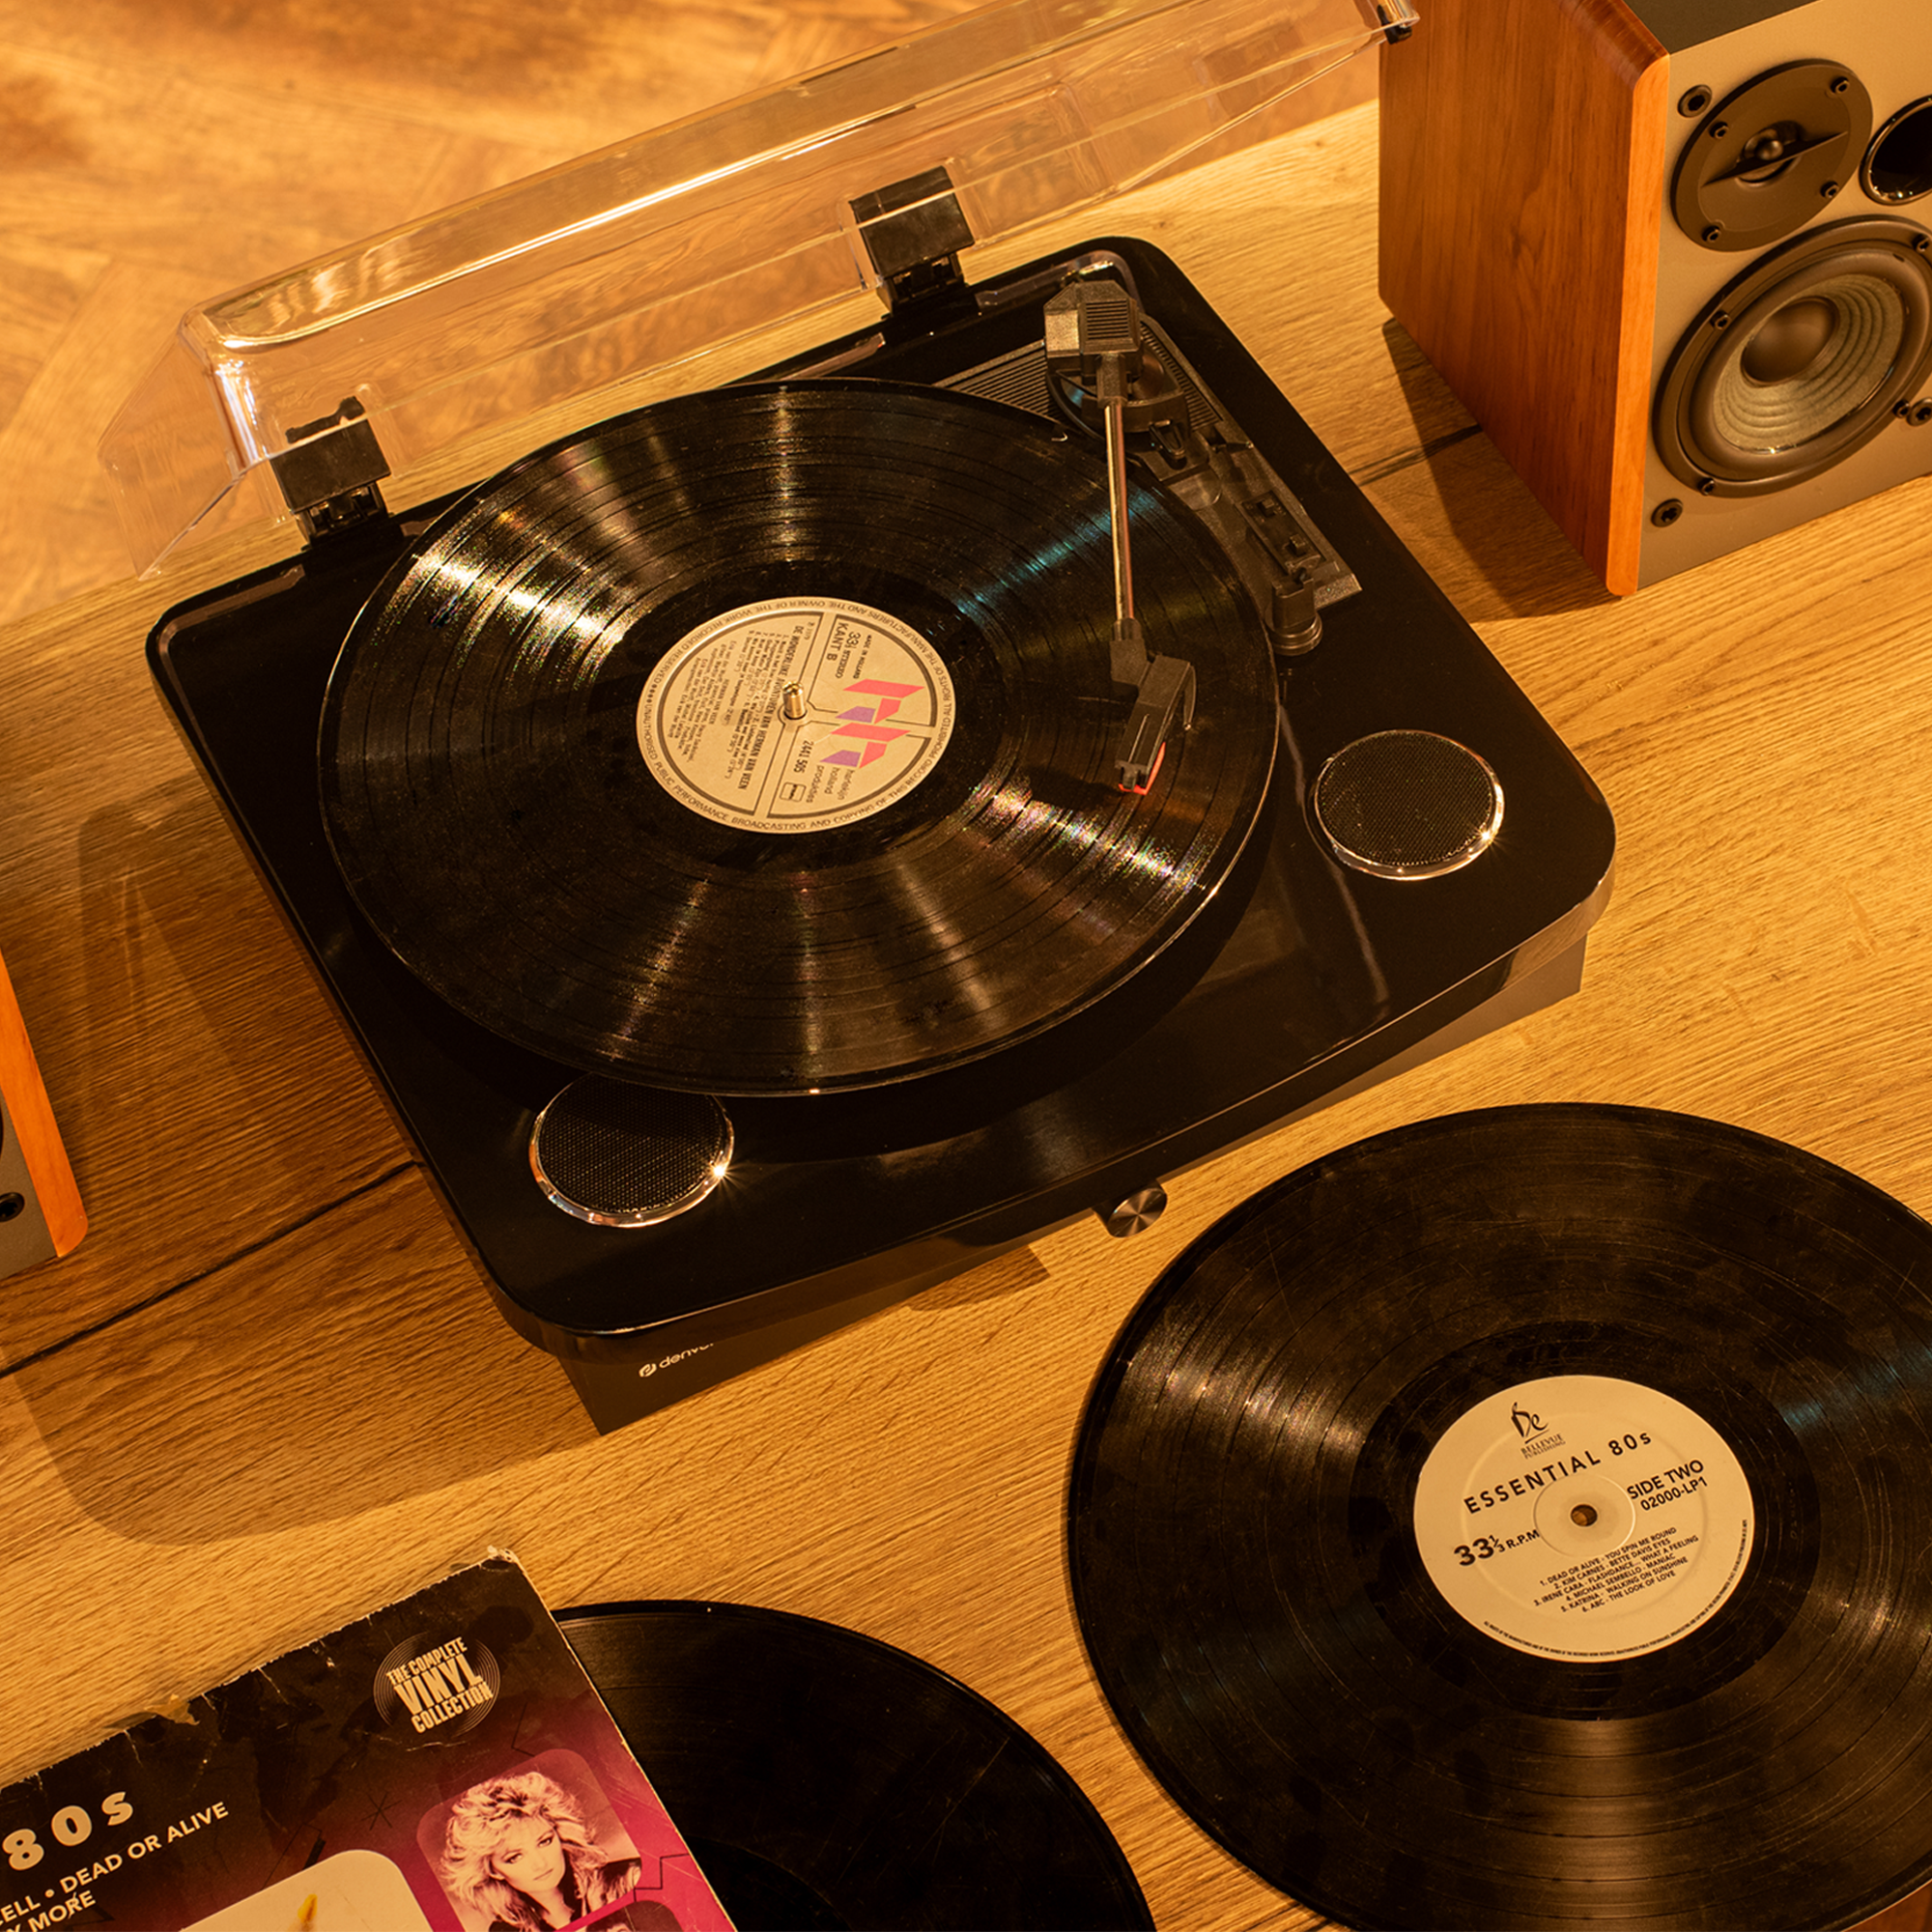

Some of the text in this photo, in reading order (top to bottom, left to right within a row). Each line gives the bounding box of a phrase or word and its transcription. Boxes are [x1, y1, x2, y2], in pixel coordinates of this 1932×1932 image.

[721, 608, 752, 623] WORK
[753, 603, 772, 611] THE
[828, 601, 846, 610] THE
[846, 604, 868, 614] AND
[677, 618, 723, 650] RECORDED
[792, 625, 805, 635] DE
[830, 622, 849, 650] KANT
[867, 611, 929, 653] MANUFACTURERS
[923, 651, 938, 666] THE
[932, 663, 945, 675] OF
[938, 675, 952, 701] RIGHTS
[759, 716, 773, 728] VAN
[943, 702, 952, 715] ALL
[750, 729, 767, 756] HERMAN
[793, 740, 814, 774] 2441 505
[650, 761, 674, 787] PUBLIC
[669, 785, 729, 821] PERFORMANCE
[730, 816, 807, 831] BROADCASTING
[810, 819, 832, 829] AND
[833, 804, 875, 824] COPYING
[874, 796, 890, 808] OF
[888, 783, 908, 799] THIS
[904, 758, 932, 786] RECORD
[928, 718, 951, 758] PROHIBITED
[737, 773, 752, 790] VEEN
[744, 758, 757, 772] VAN
[824, 766, 841, 795] holland
[1520, 1433, 1564, 1456] BELLEVUE
[1463, 1433, 1652, 1514] ESSENTIAL 80s
[1627, 1460, 1704, 1499] SIDE TWO
[1640, 1476, 1708, 1511] 02000-LP1
[1541, 1591, 1563, 1604] IRENE
[1563, 1581, 1584, 1595] CARA
[1641, 1549, 1662, 1563] WHAT
[1669, 1535, 1699, 1551] FEELING
[1547, 1572, 1568, 1584] DEAD
[1568, 1566, 1579, 1577] OR
[1580, 1557, 1601, 1571] ALIVE
[1604, 1549, 1621, 1561] YOU
[1621, 1543, 1638, 1554] SPIN
[1638, 1538, 1649, 1548] ME
[1650, 1527, 1677, 1543] ROUND
[1562, 1575, 1576, 1586] KIM
[1577, 1564, 1605, 1580] CARNES
[1608, 1553, 1631, 1567] BETTE
[1631, 1545, 1653, 1558] DAVIS
[1653, 1538, 1671, 1549] EYES
[1569, 1594, 1599, 1609] KATRINA
[1605, 1577, 1640, 1594] WALKING
[1639, 1571, 1652, 1580] ON
[1653, 1556, 1689, 1576] SUNSHINE
[1573, 1582, 1605, 1598] MICHAEL
[1605, 1567, 1643, 1587] SEMBELLO
[1646, 1553, 1676, 1570] MANIAC
[1590, 1599, 1605, 1609] ABC
[1608, 1591, 1624, 1602] THE
[1624, 1582, 1644, 1596] LOOK
[1644, 1577, 1656, 1587] OF
[1657, 1570, 1676, 1582] LOVE
[385, 1636, 468, 1686] THE COMPLETE
[393, 1653, 483, 1716] VINYL
[411, 1681, 494, 1734] COLLECTION
[2, 1791, 133, 1871] 80s
[0, 1801, 229, 1926] ELL DEAD OR ALIVE
[27, 1889, 96, 1932] MORE
